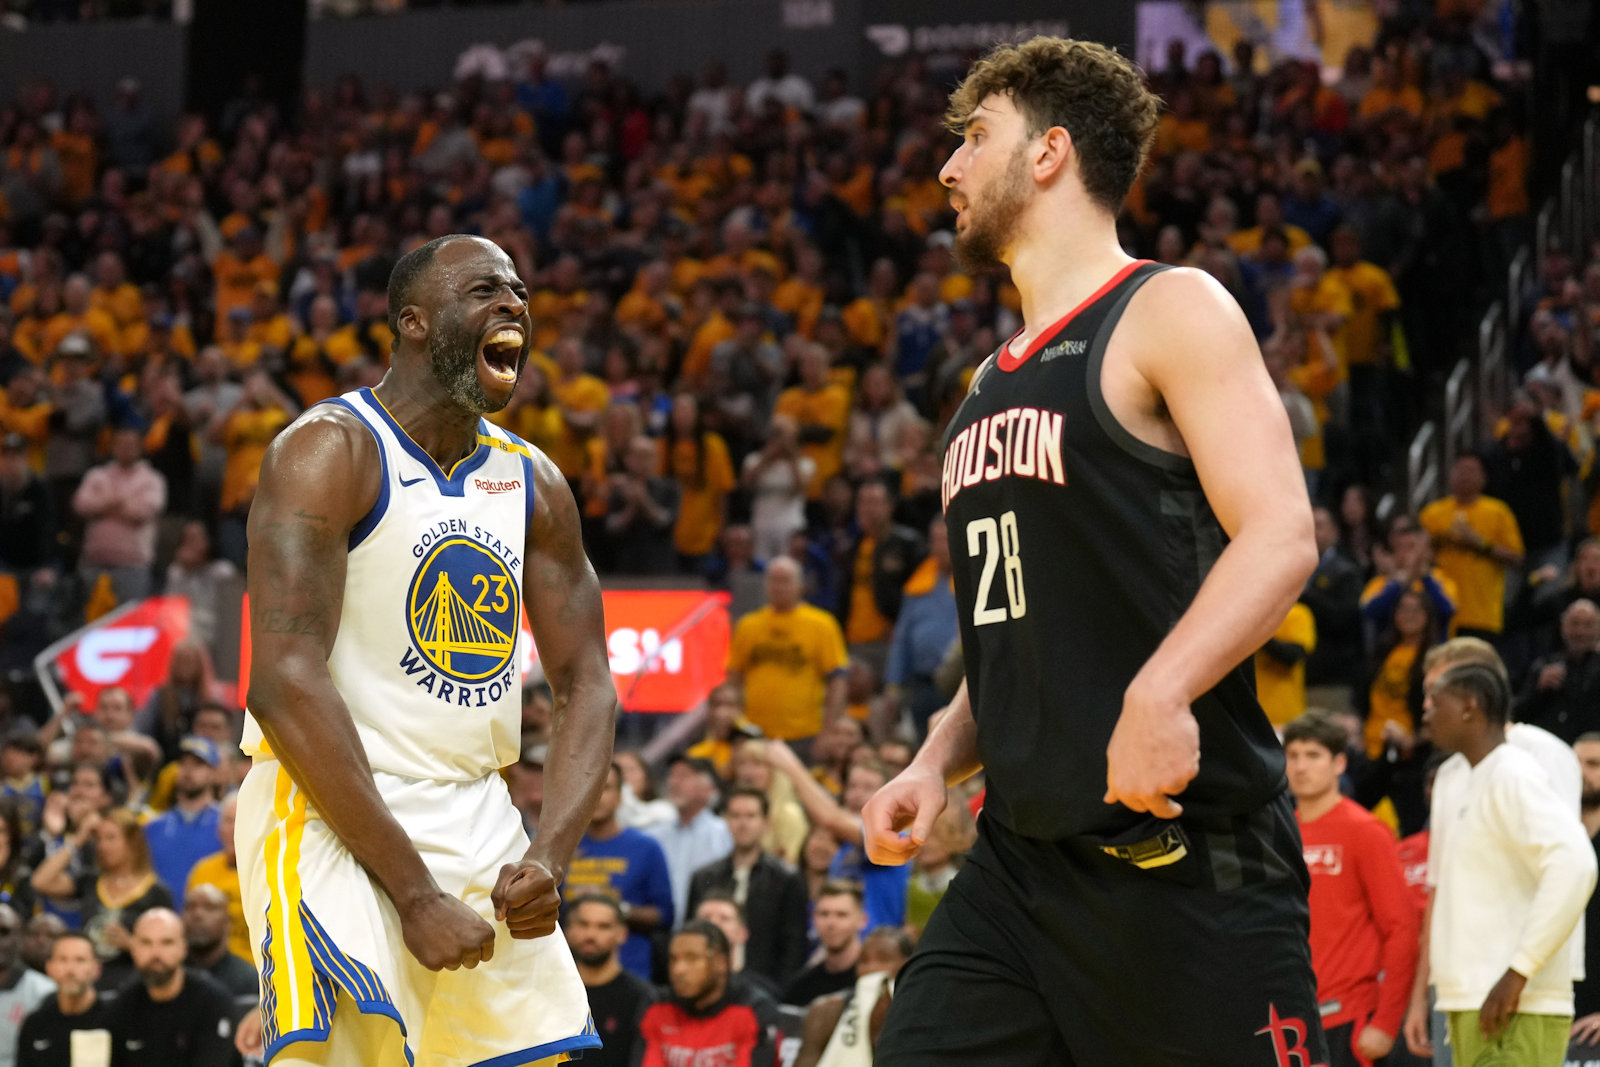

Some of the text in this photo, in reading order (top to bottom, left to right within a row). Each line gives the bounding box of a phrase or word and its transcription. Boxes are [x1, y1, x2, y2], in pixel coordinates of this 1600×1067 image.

[498, 440, 508, 451] 16
[941, 407, 1066, 517] HOUSTON
[474, 479, 521, 493] Rakuten
[412, 518, 521, 571] GOLDEN STATE
[966, 510, 1027, 626] 28
[472, 574, 510, 613] 23
